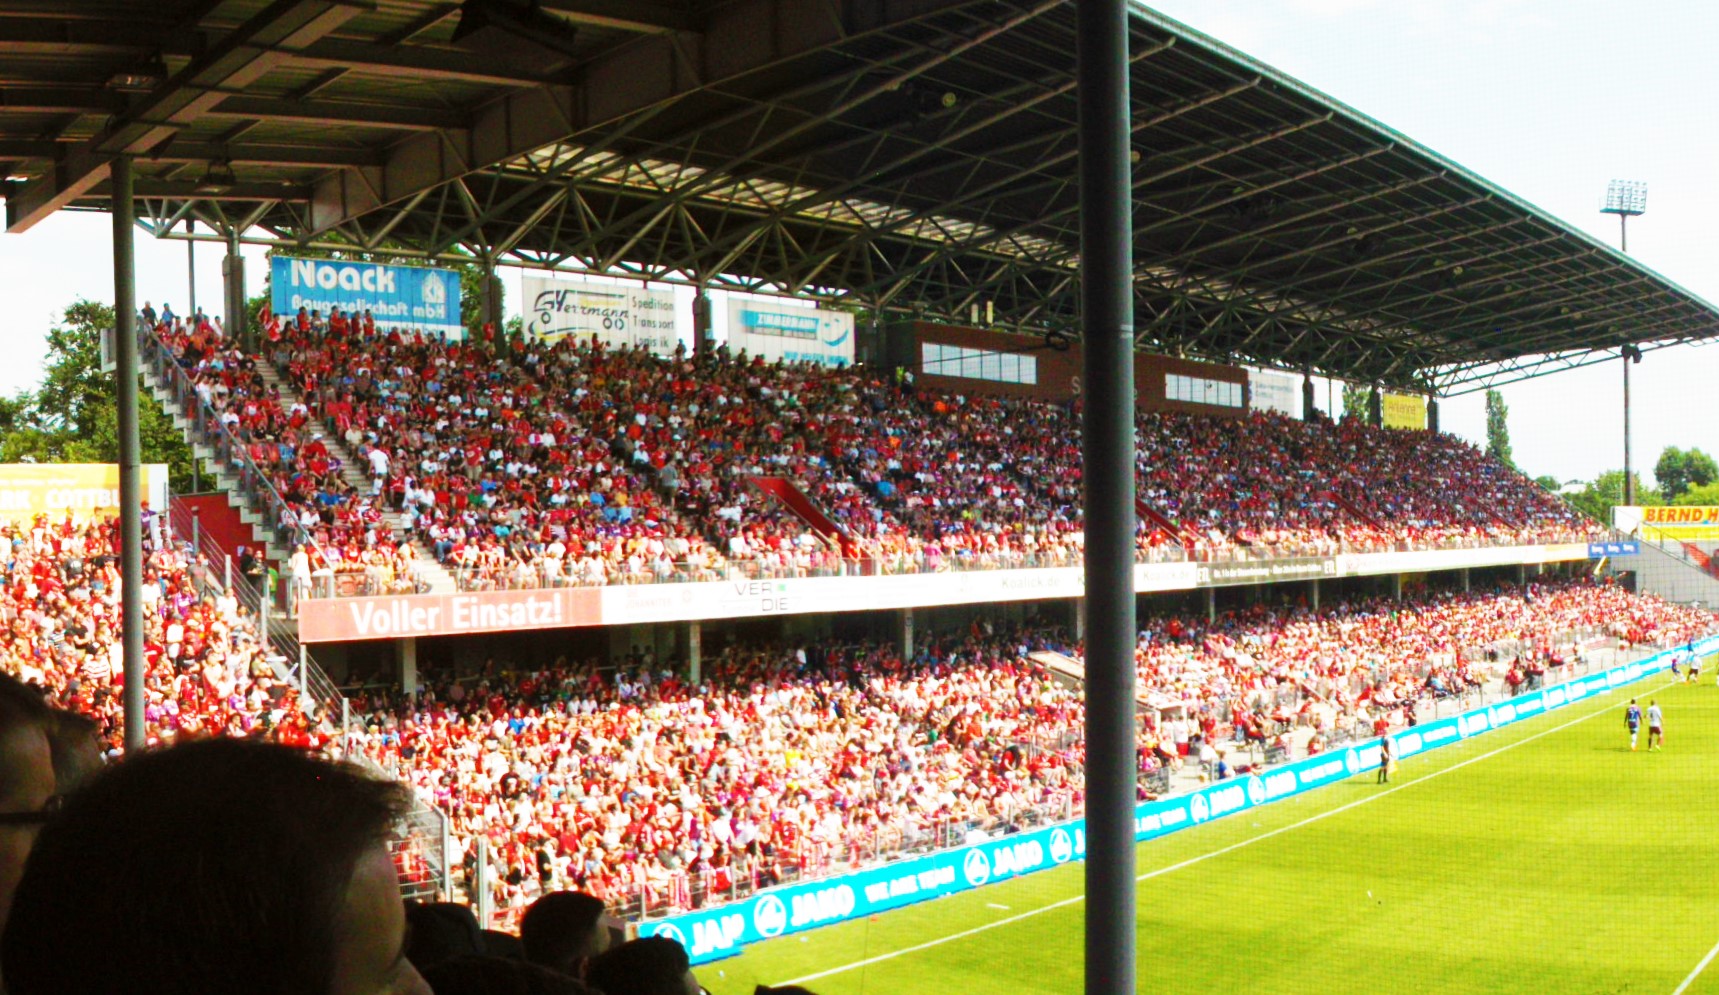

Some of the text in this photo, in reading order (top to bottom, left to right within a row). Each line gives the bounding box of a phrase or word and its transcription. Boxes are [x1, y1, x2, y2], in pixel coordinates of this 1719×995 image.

[290, 259, 395, 293] Noack
[632, 296, 675, 312] Spedition
[1645, 507, 1704, 523] BERND
[350, 592, 563, 636] Voller Einsatz!
[761, 597, 788, 612] DIE
[790, 884, 854, 927] JAKO
